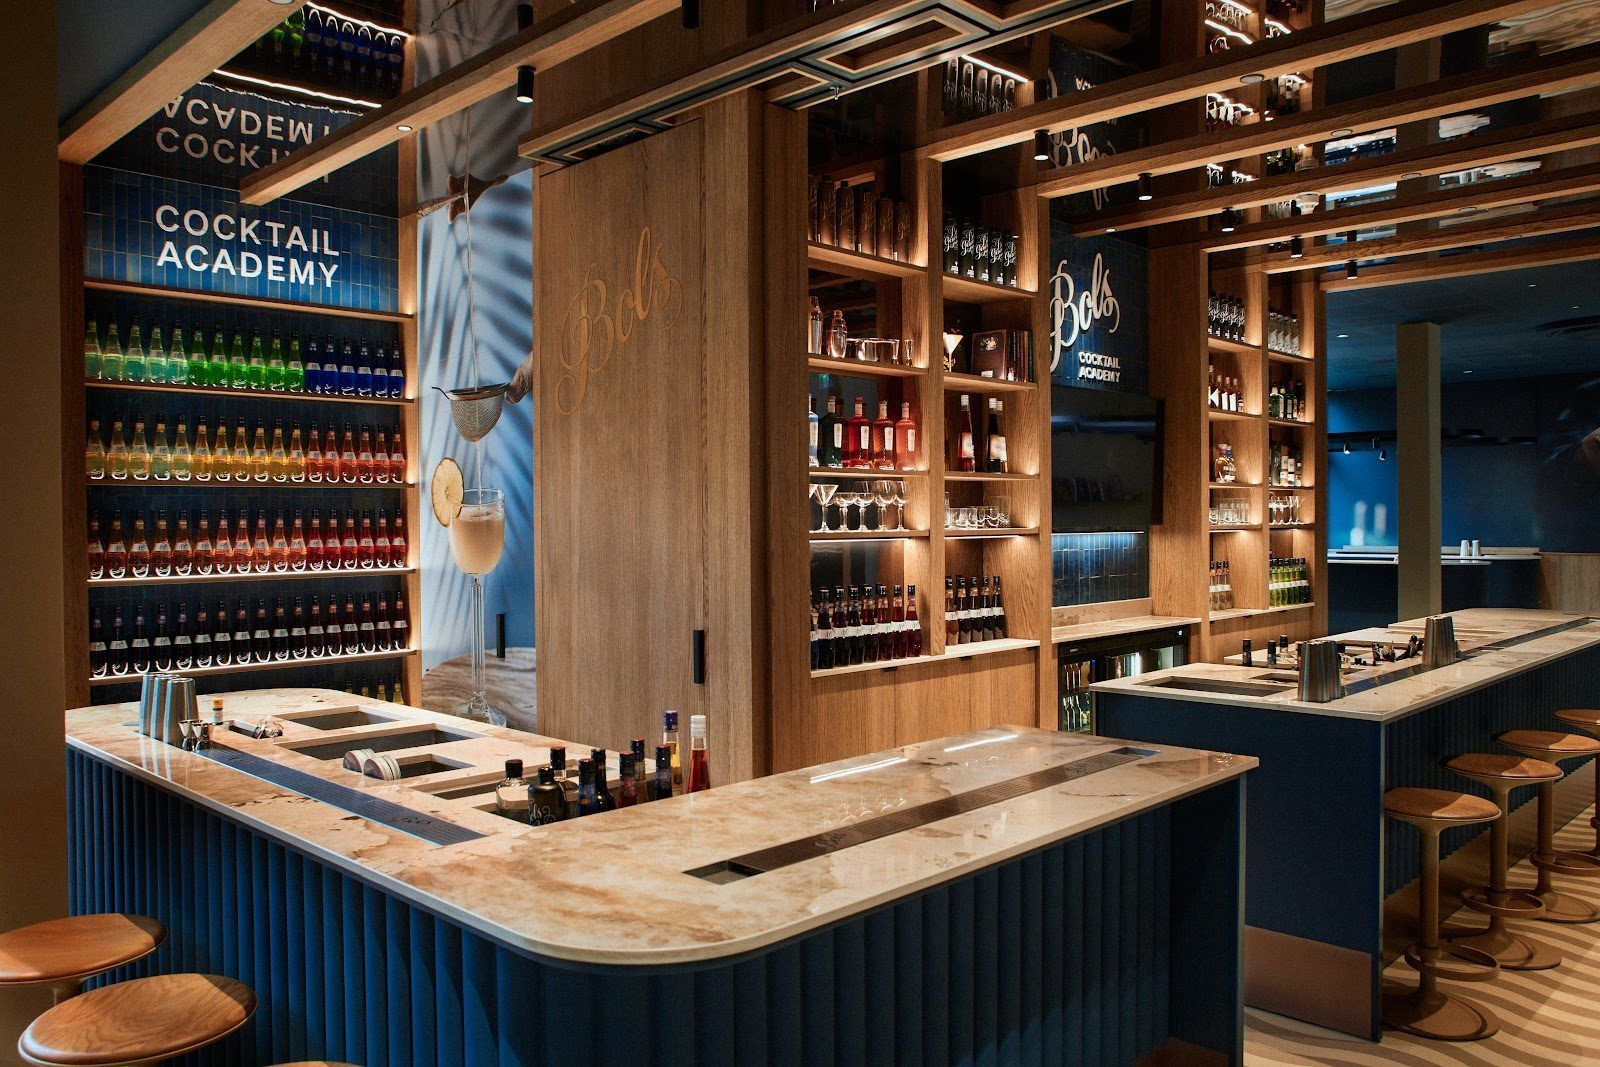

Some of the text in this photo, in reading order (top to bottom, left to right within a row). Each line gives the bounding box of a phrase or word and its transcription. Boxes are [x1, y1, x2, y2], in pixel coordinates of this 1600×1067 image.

[155, 204, 340, 257] COCKTAIL
[156, 241, 339, 288] ACADEMY
[557, 226, 683, 415] Bols
[1049, 252, 1121, 373] Bols
[1078, 350, 1121, 369] COCKTAIL
[1078, 366, 1121, 383] ACADEMY
